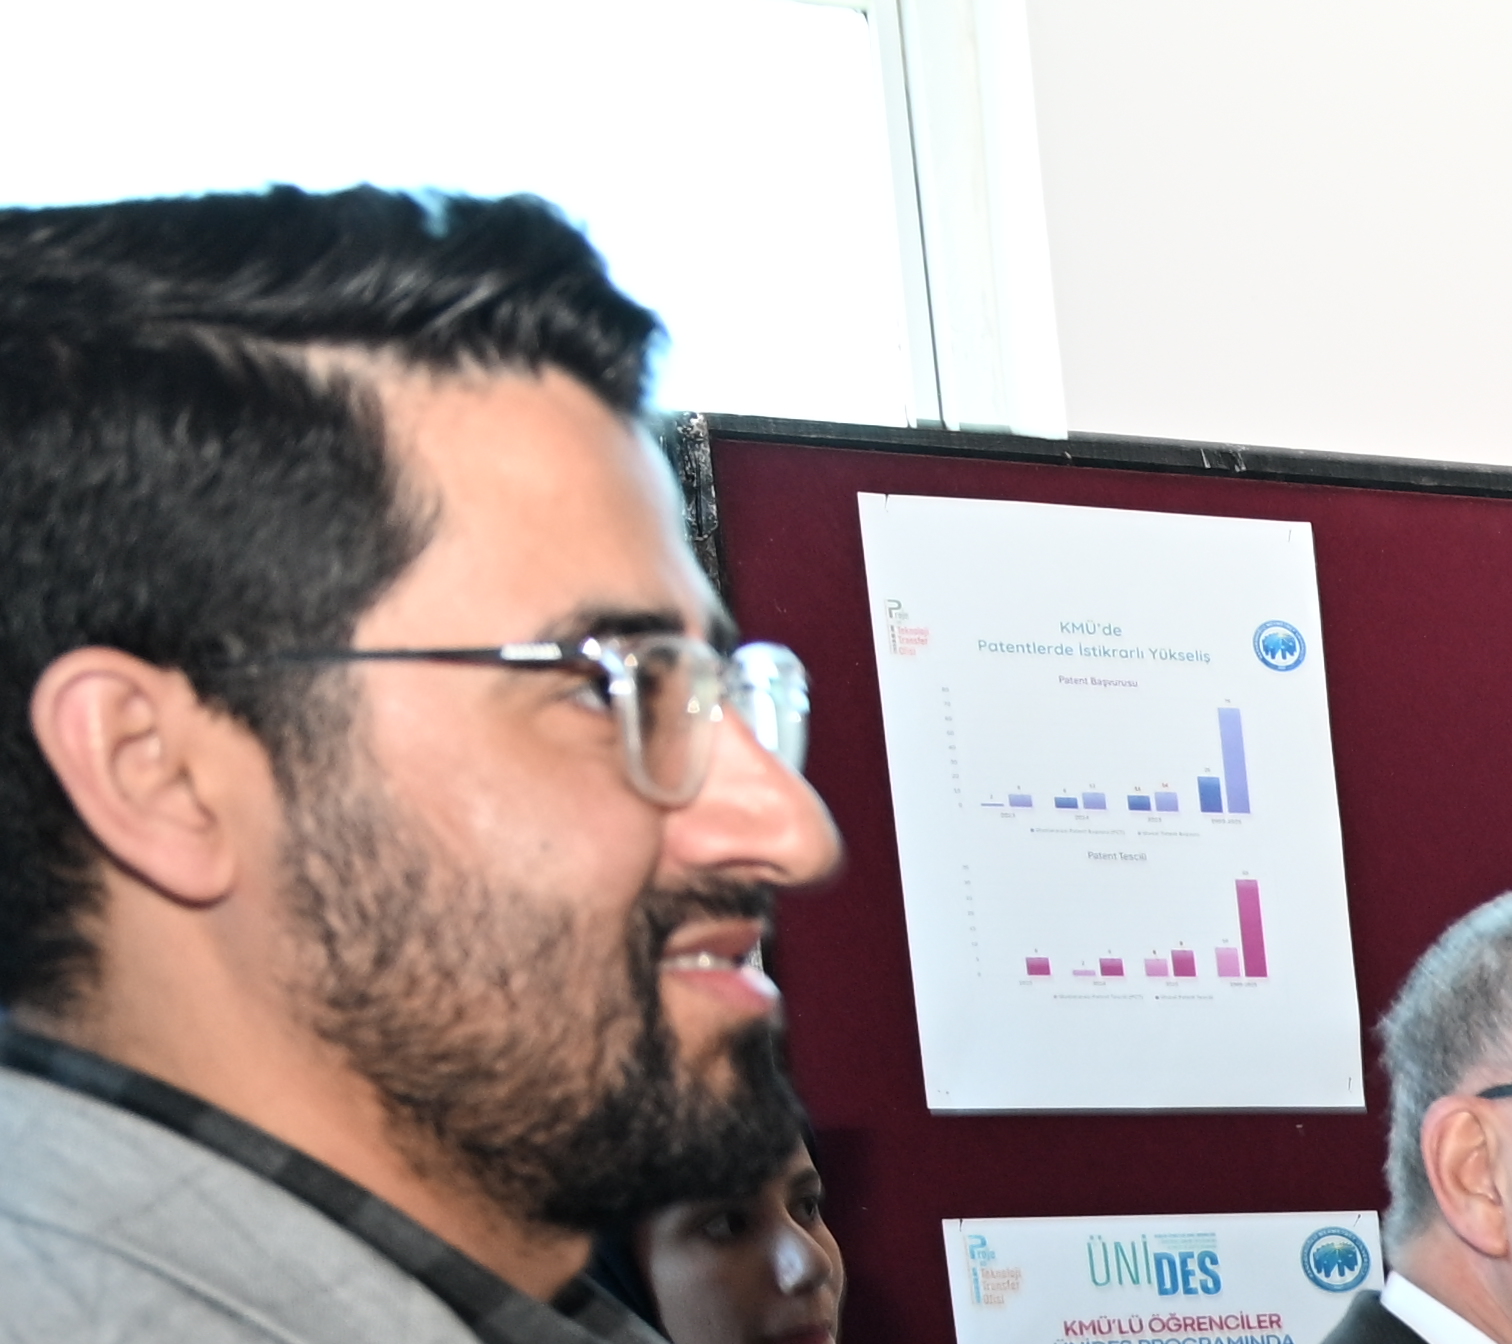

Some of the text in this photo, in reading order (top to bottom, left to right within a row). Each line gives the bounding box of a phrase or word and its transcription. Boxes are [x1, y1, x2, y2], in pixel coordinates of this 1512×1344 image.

[1060, 619, 1122, 637] KMÜ'de
[978, 640, 1212, 665] Patentlerde İstikrarlı Yükseliş
[1059, 675, 1089, 686] Patent
[1063, 1311, 1282, 1337] KMÜ'LÜ ÖĞRENCİLER
